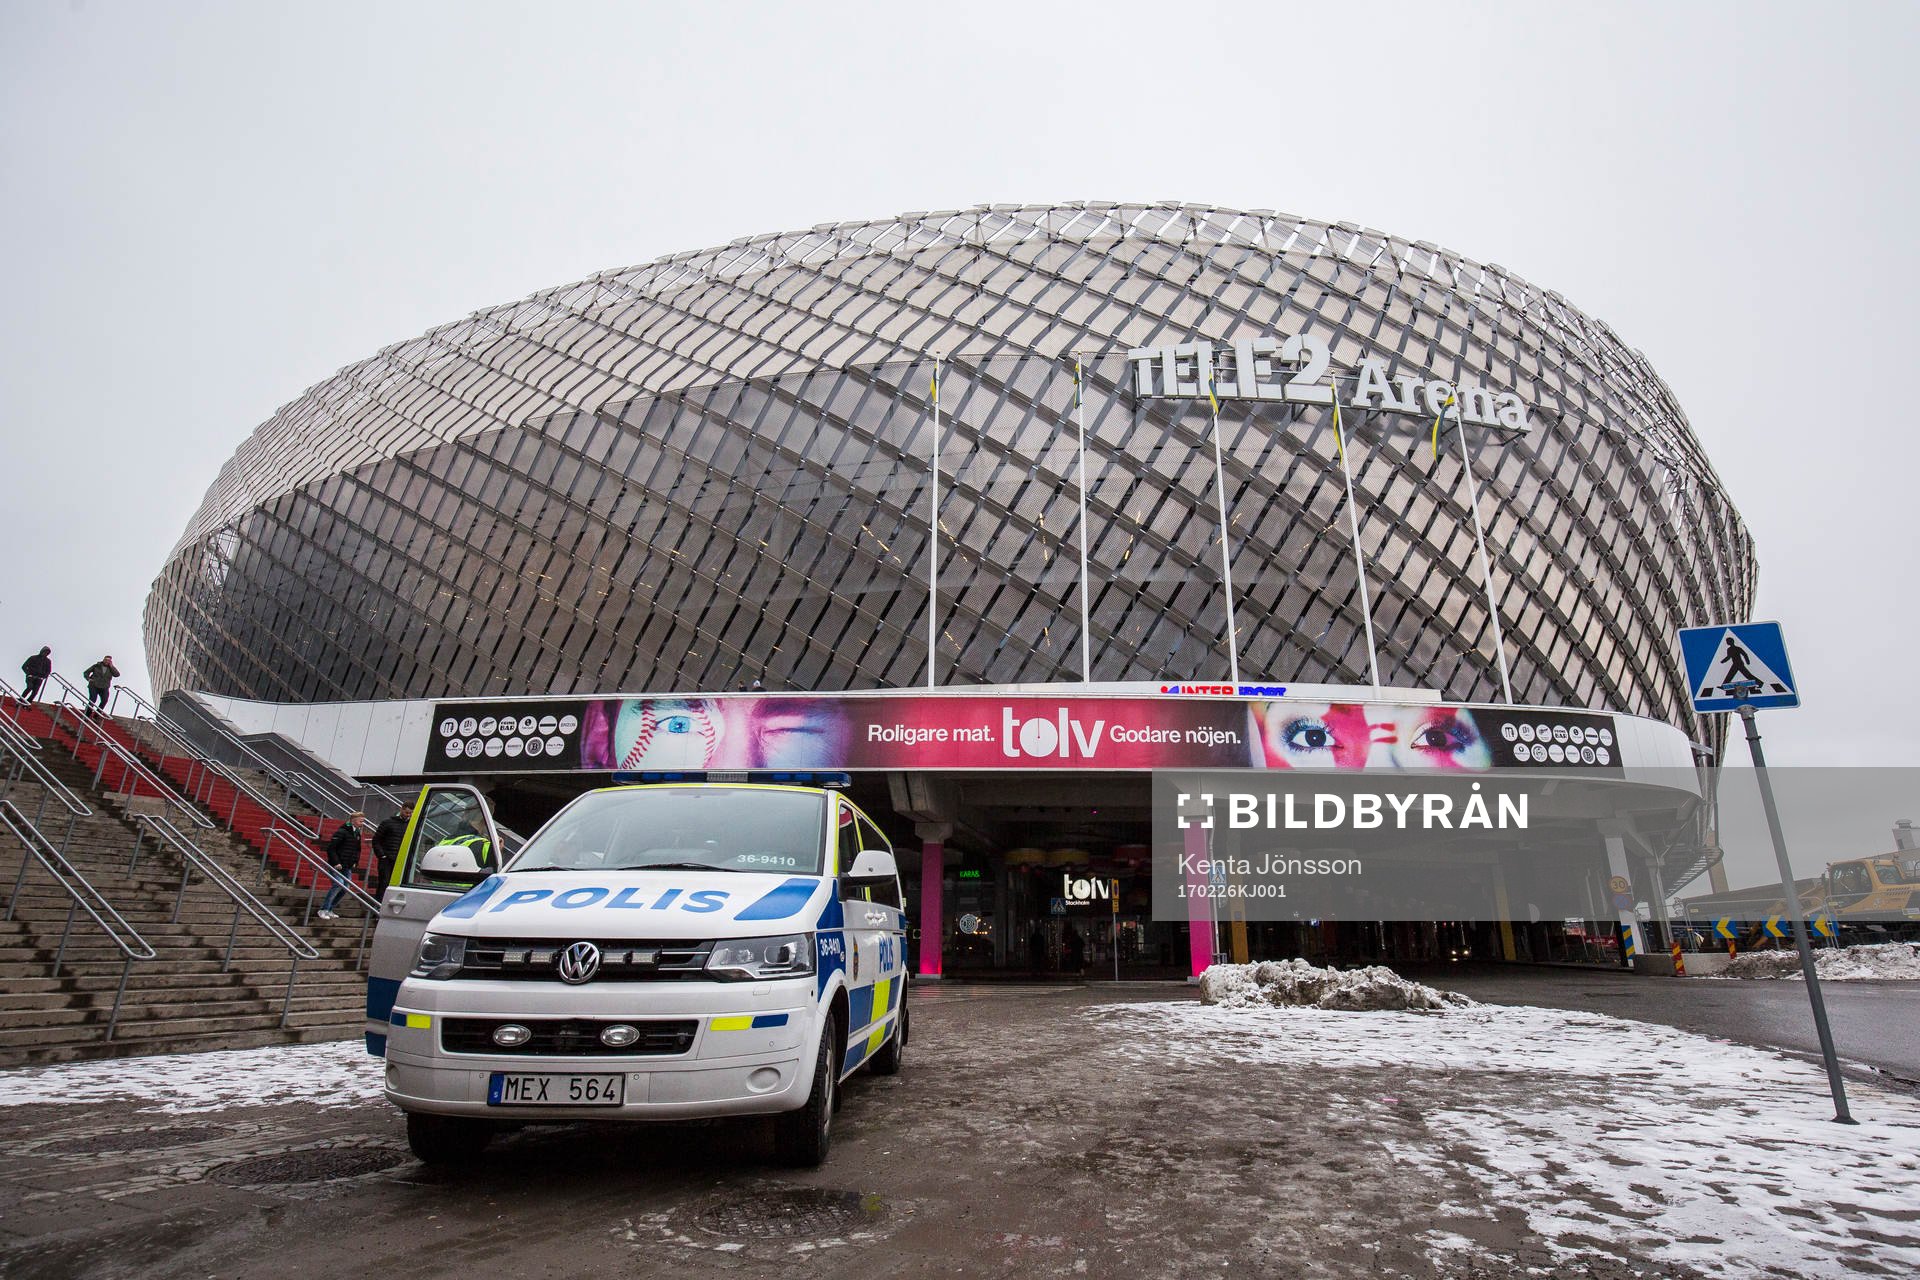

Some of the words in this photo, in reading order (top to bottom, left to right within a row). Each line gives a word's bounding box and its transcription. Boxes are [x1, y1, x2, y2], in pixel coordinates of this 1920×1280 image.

[1128, 333, 1335, 404] TELE2
[1351, 357, 1532, 434] Arena
[868, 723, 948, 746] Roligare
[952, 725, 996, 743] mat.
[1002, 706, 1106, 758] tolv
[1109, 724, 1182, 744] Godare
[1185, 725, 1242, 746] nöjen.
[736, 854, 796, 867] 36-9410
[1063, 873, 1110, 900] tolv
[1611, 881, 1626, 890] 30
[488, 886, 730, 914] POLIS
[504, 1077, 551, 1101] MEX
[569, 1078, 616, 1101] 564
